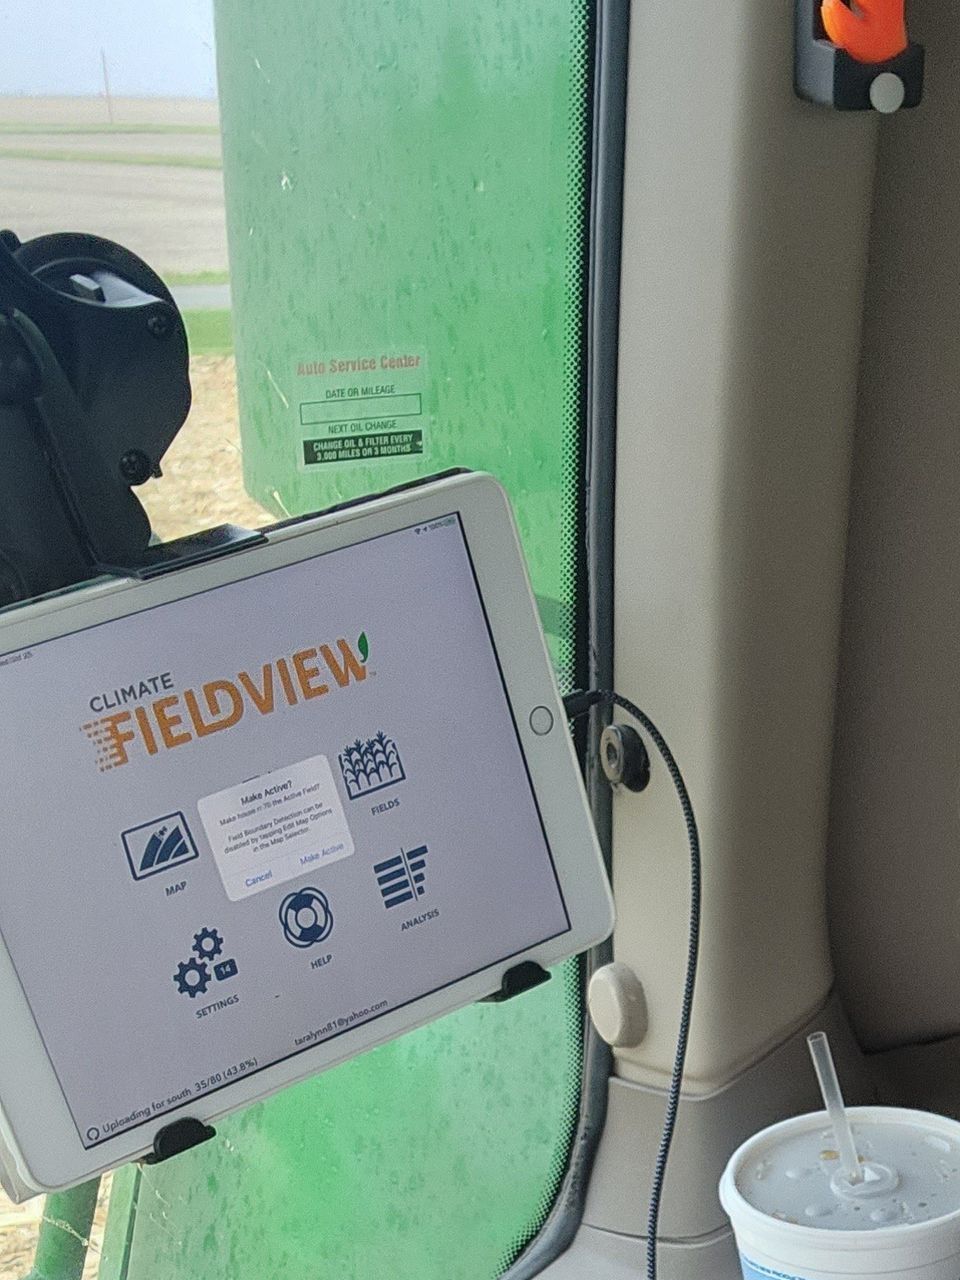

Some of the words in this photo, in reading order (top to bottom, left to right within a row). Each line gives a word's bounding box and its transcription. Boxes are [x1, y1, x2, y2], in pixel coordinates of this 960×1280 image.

[297, 362, 325, 376] Auto
[329, 357, 376, 373] Service
[380, 355, 420, 369] Center
[325, 388, 346, 399] DATE
[347, 387, 360, 397] OR
[361, 385, 396, 395] MILEAGE
[328, 424, 348, 434] NEXT
[350, 422, 363, 432] OIL
[365, 420, 398, 431] CHANGE
[313, 440, 343, 452] CHANGE
[344, 439, 357, 448] OIL
[365, 436, 389, 446] FILTER
[390, 434, 413, 443] EVERY
[338, 449, 360, 458] MILES
[362, 447, 373, 456] OR
[380, 444, 412, 454] MONTHS
[89, 672, 175, 713] CLIMATE
[80, 638, 368, 772] FIELDVIEW
[240, 792, 263, 806] Make
[264, 780, 293, 797] Active?
[371, 798, 400, 816] FIELDS
[244, 821, 273, 838] Boundary
[273, 810, 303, 826] Detection
[303, 806, 314, 815] can
[245, 870, 273, 887] Cancel
[300, 853, 320, 865] Make
[321, 843, 344, 858] Active
[165, 880, 188, 897] MAP
[401, 908, 440, 932] ANALYSIS
[310, 954, 333, 970] HELP
[195, 994, 240, 1020] SETTINGS
[102, 1103, 151, 1134] Uploading
[152, 1099, 166, 1113] for
[167, 1087, 192, 1107] south
[194, 1073, 222, 1094] 35/80
[223, 1057, 258, 1082] (43.8%)
